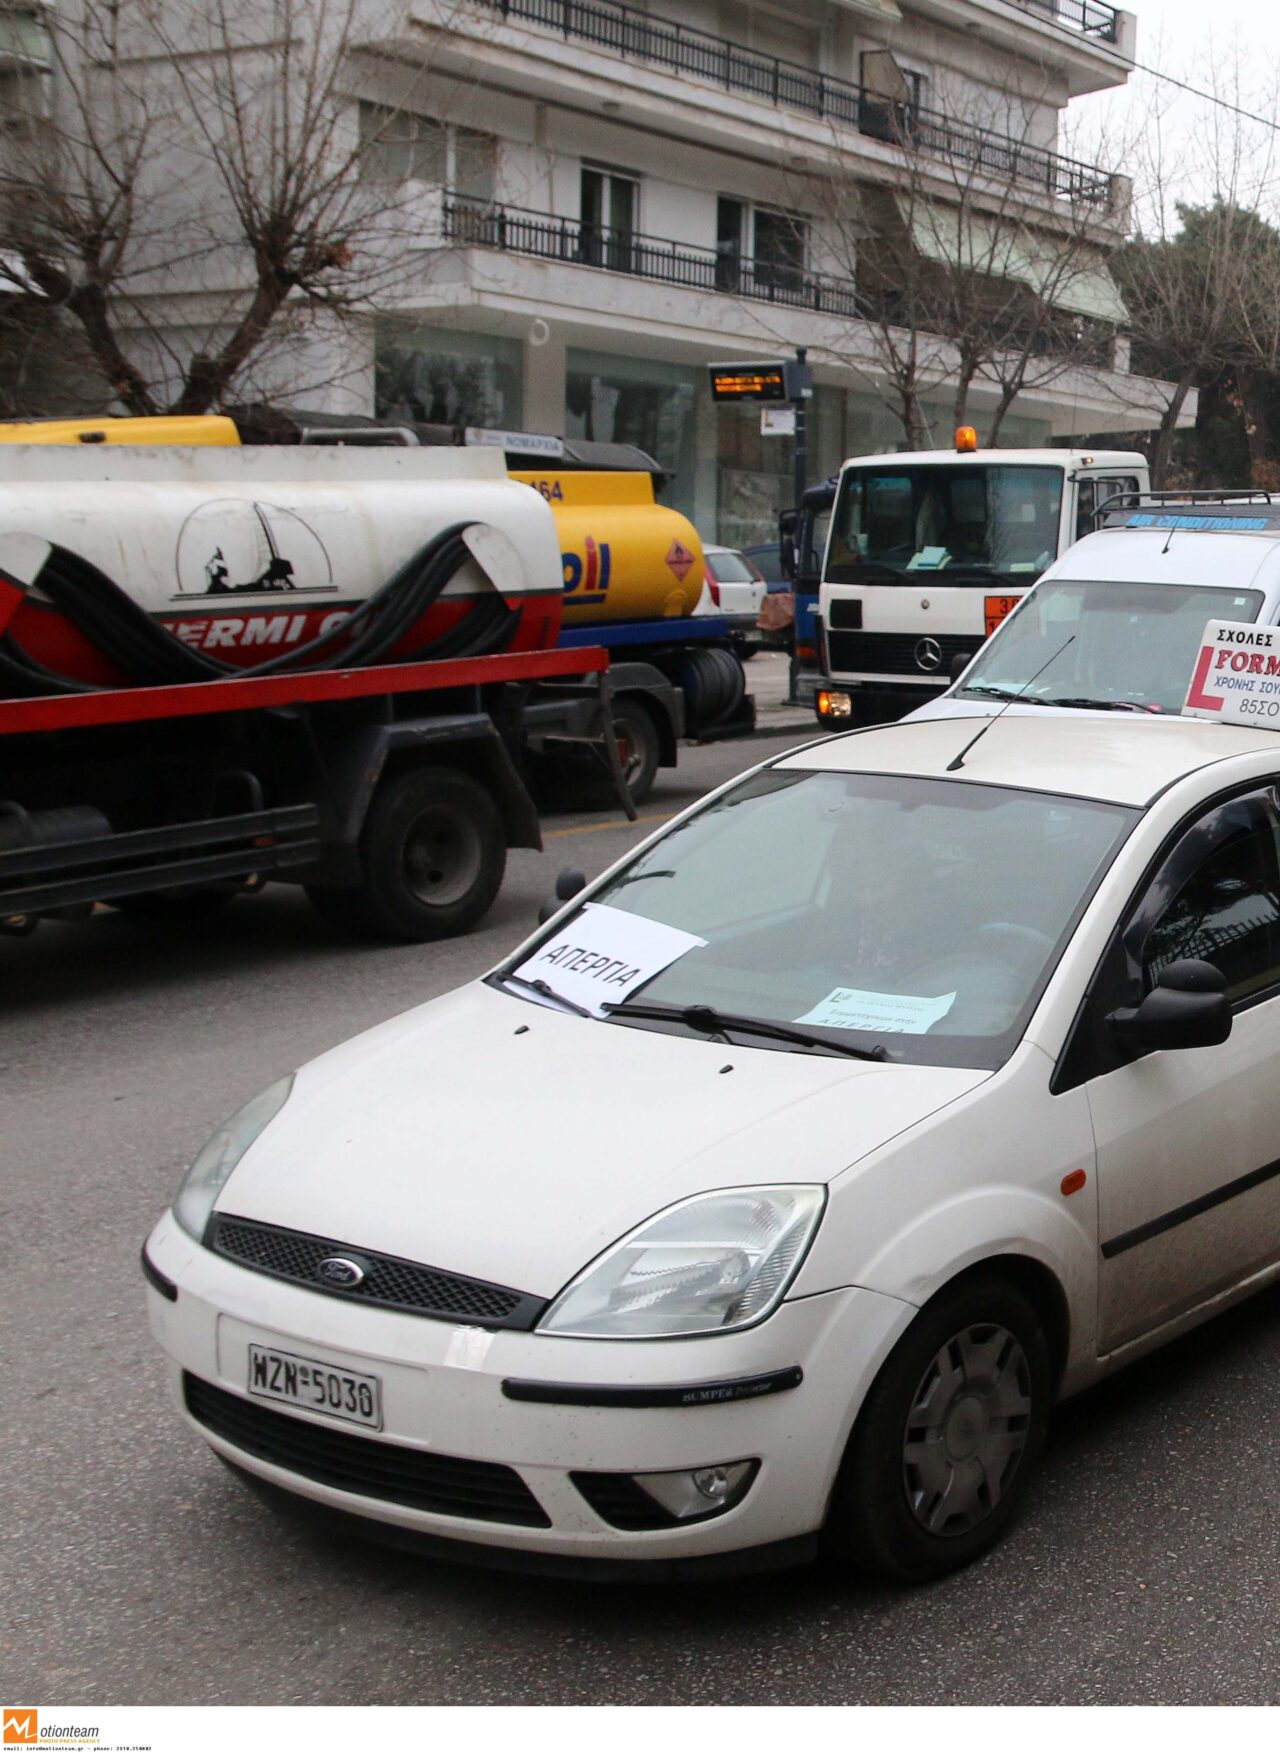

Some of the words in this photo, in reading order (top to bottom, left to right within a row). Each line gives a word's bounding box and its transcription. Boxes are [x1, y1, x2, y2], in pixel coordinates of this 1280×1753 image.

[1217, 629, 1273, 647] ΣΧΟΛΕΣ
[1187, 646, 1224, 711] L
[1214, 675, 1256, 692] ΧΡΟΝΗΣ
[540, 944, 641, 987] ΑΠΕΡΓΙΑ
